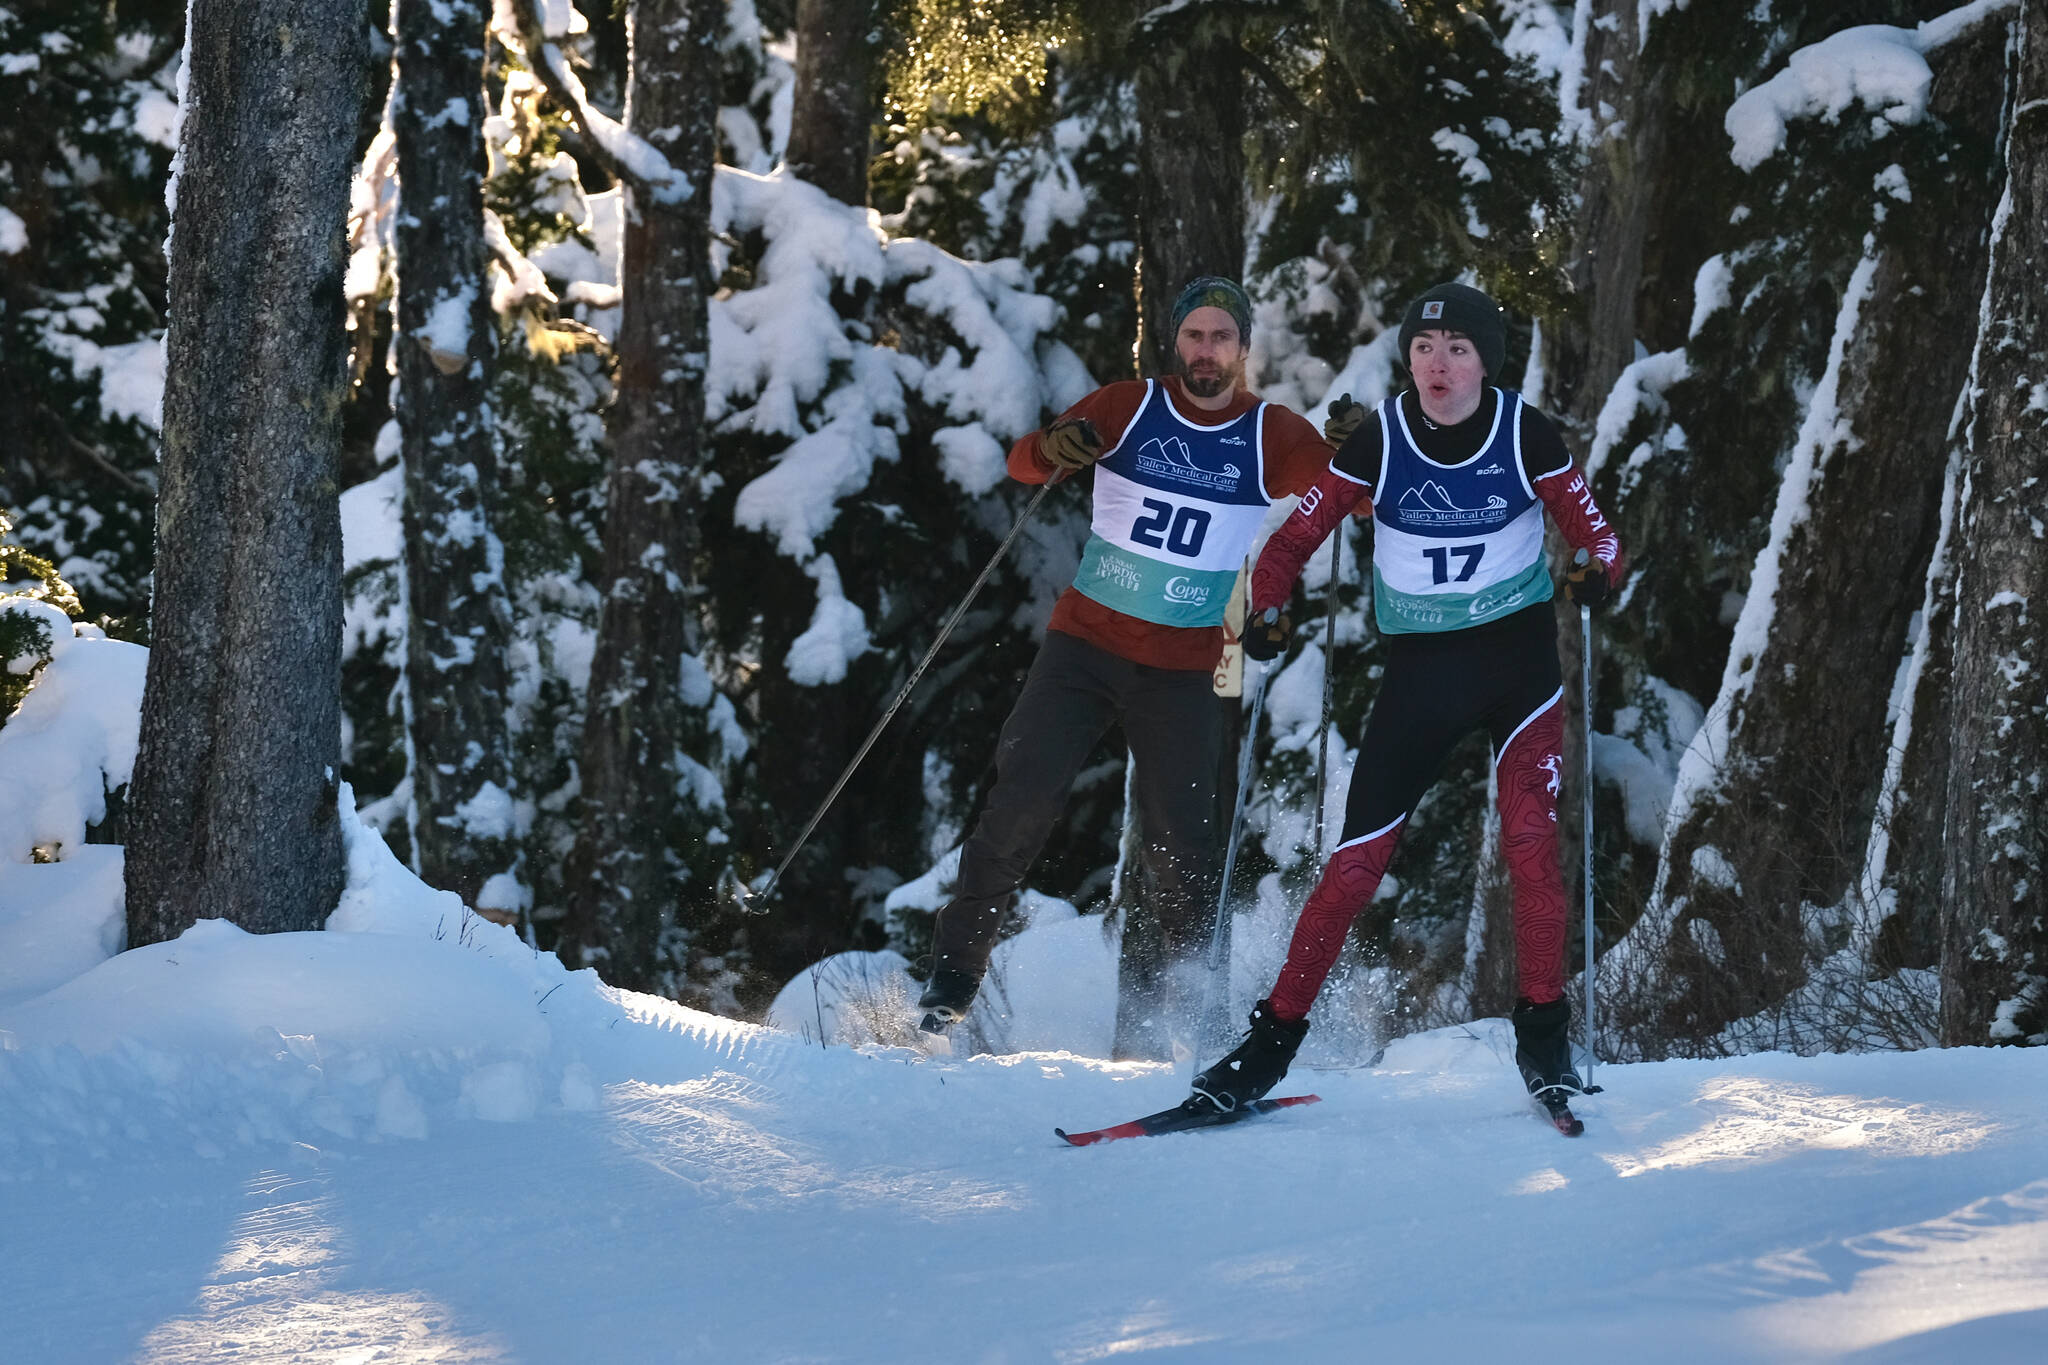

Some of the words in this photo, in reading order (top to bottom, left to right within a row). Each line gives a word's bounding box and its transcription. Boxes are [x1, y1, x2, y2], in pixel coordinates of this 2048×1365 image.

[1138, 457, 1168, 472] Valley
[1171, 466, 1211, 481] Medical
[1213, 474, 1238, 486] Care
[1400, 510, 1432, 520] Valley
[1435, 510, 1478, 521] Medical
[1480, 509, 1507, 518] Care
[1567, 473, 1607, 532] KALÉ
[1130, 496, 1212, 557] 20
[1098, 556, 1142, 582] NORDIC
[1422, 542, 1486, 585] 17
[1114, 575, 1140, 591] CLUB
[1165, 576, 1210, 600] Coppa
[1414, 610, 1444, 624] CLUB
